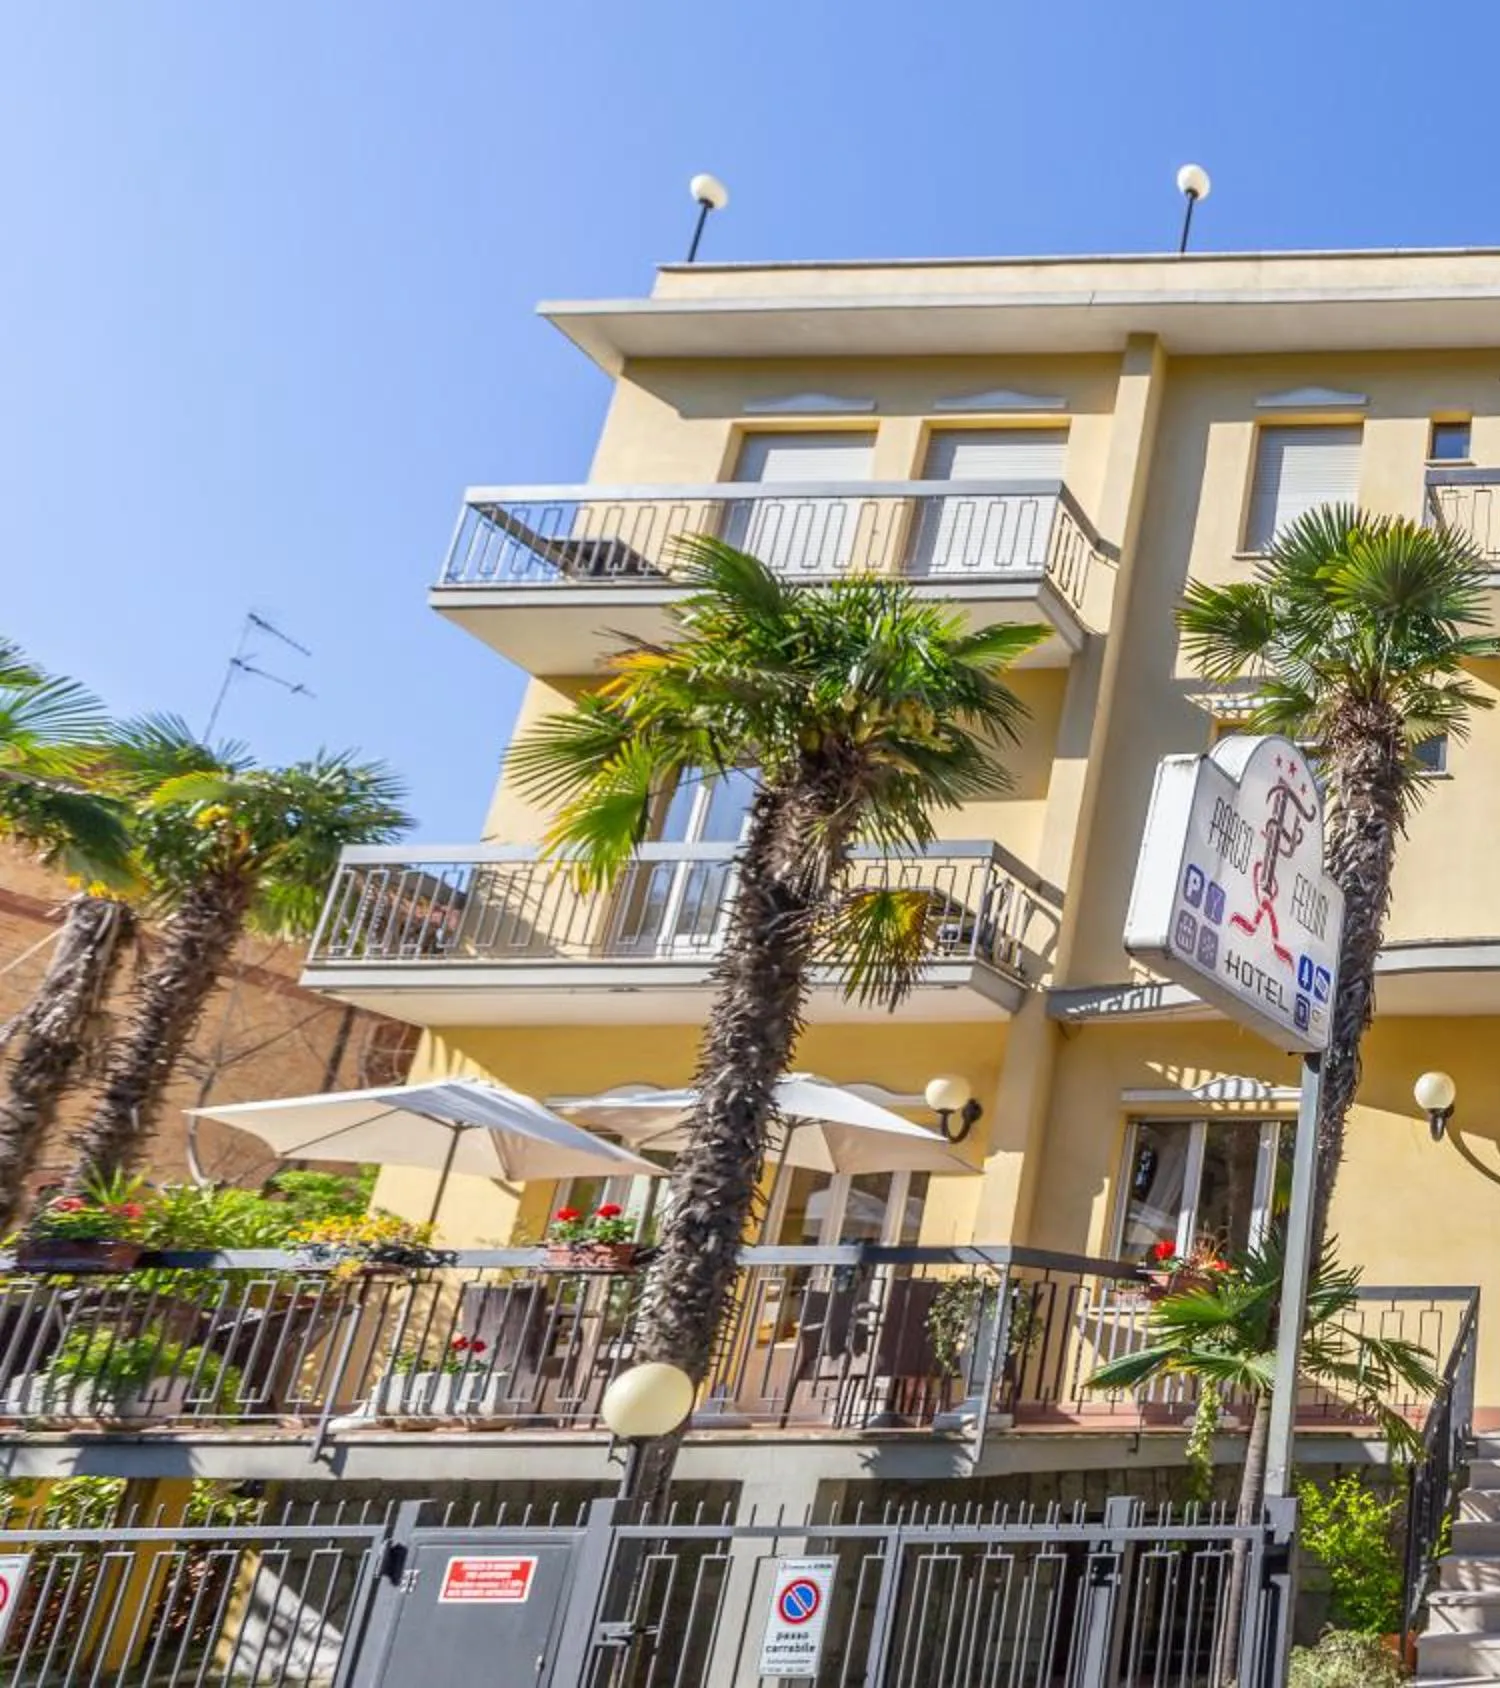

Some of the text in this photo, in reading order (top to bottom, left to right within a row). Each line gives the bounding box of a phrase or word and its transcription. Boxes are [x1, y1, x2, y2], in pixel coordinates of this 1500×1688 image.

[1223, 949, 1289, 1014] HOTEL
[776, 1631, 809, 1641] passo
[765, 1642, 816, 1653] carrabile
